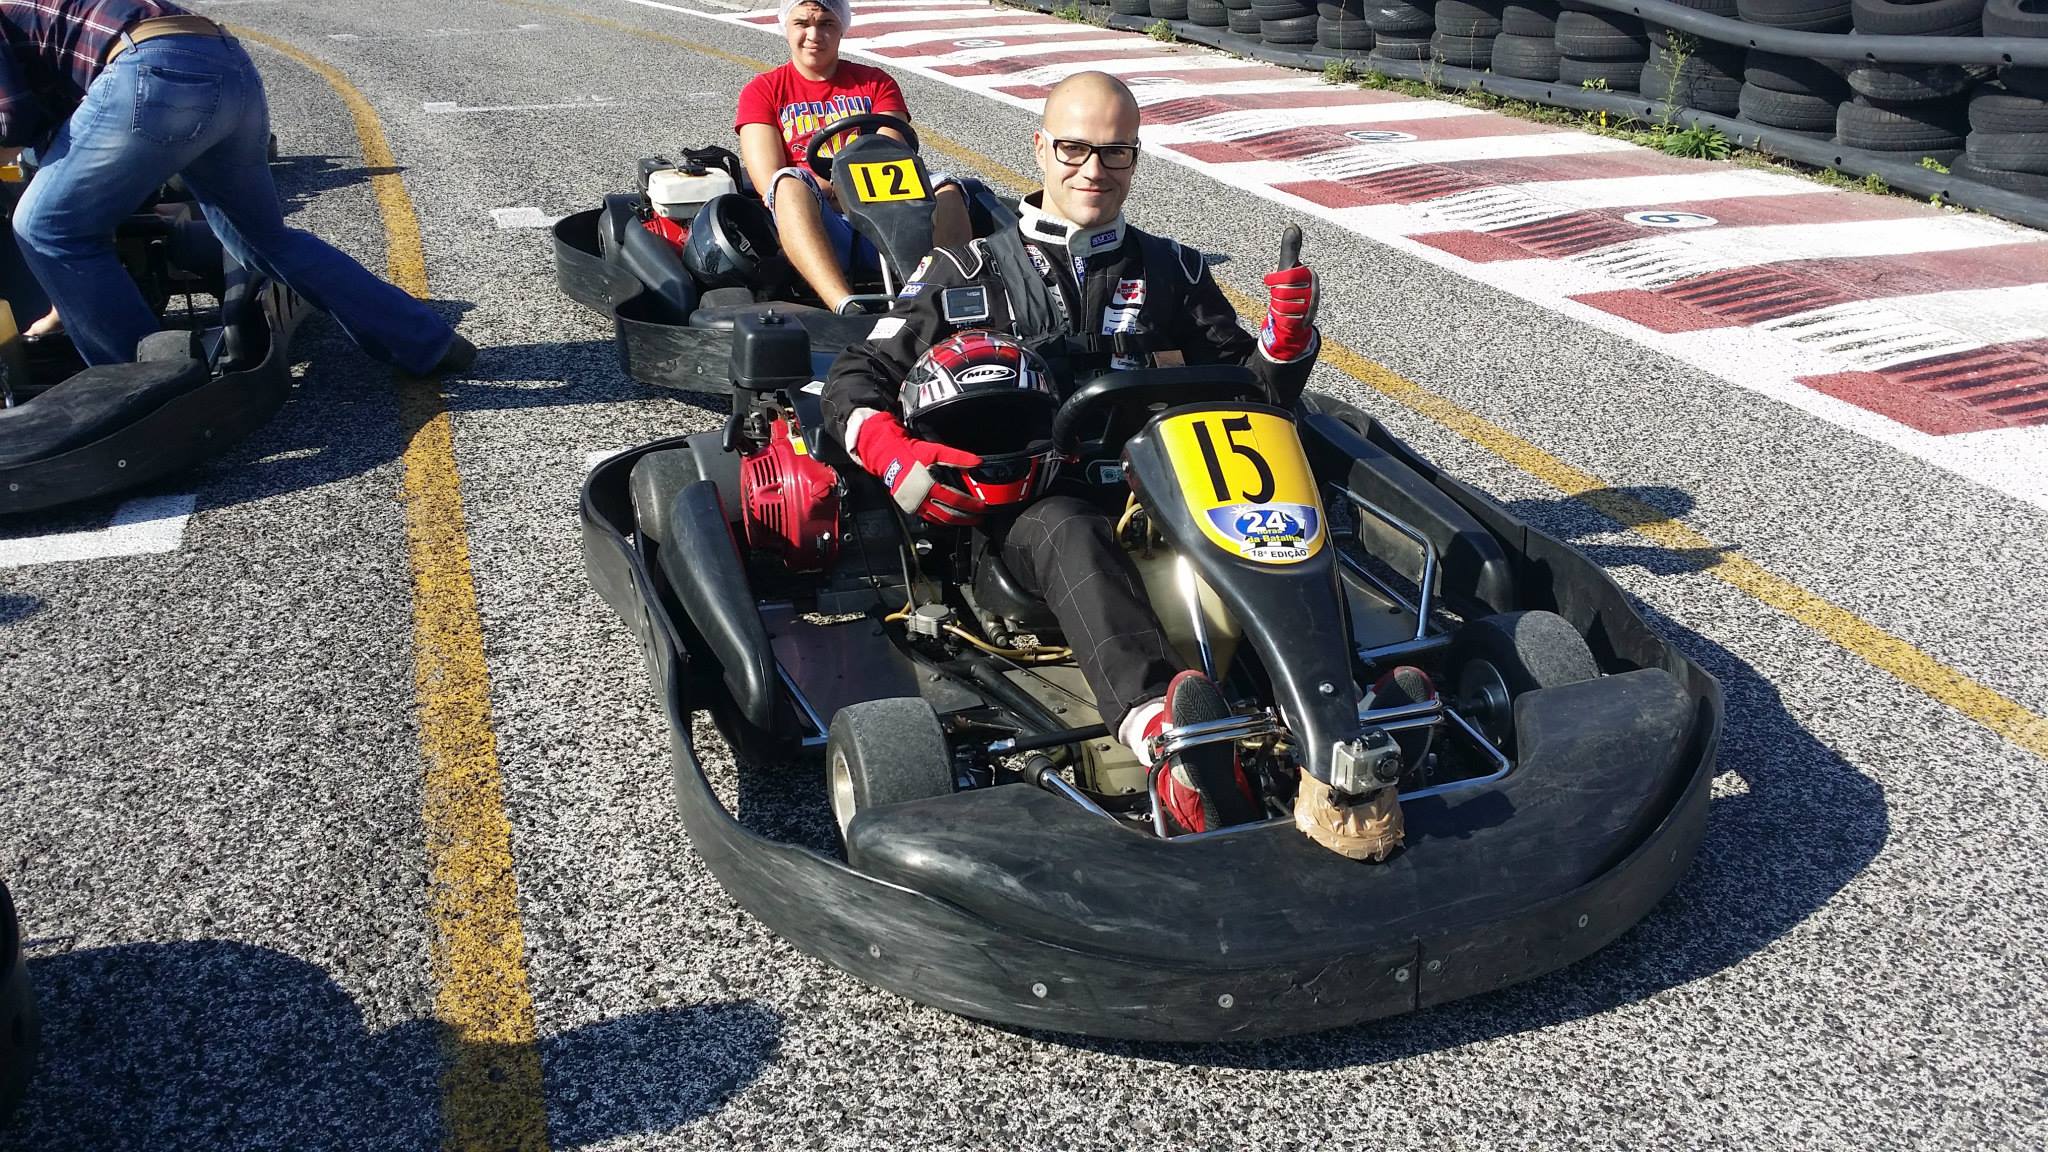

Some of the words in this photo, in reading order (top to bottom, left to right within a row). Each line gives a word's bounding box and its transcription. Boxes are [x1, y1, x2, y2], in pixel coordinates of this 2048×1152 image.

[861, 164, 911, 198] 12
[966, 369, 1008, 379] MDS
[1192, 413, 1276, 505] 15
[1263, 534, 1302, 543] Batalha
[1270, 547, 1308, 559] EDIÇÃO
